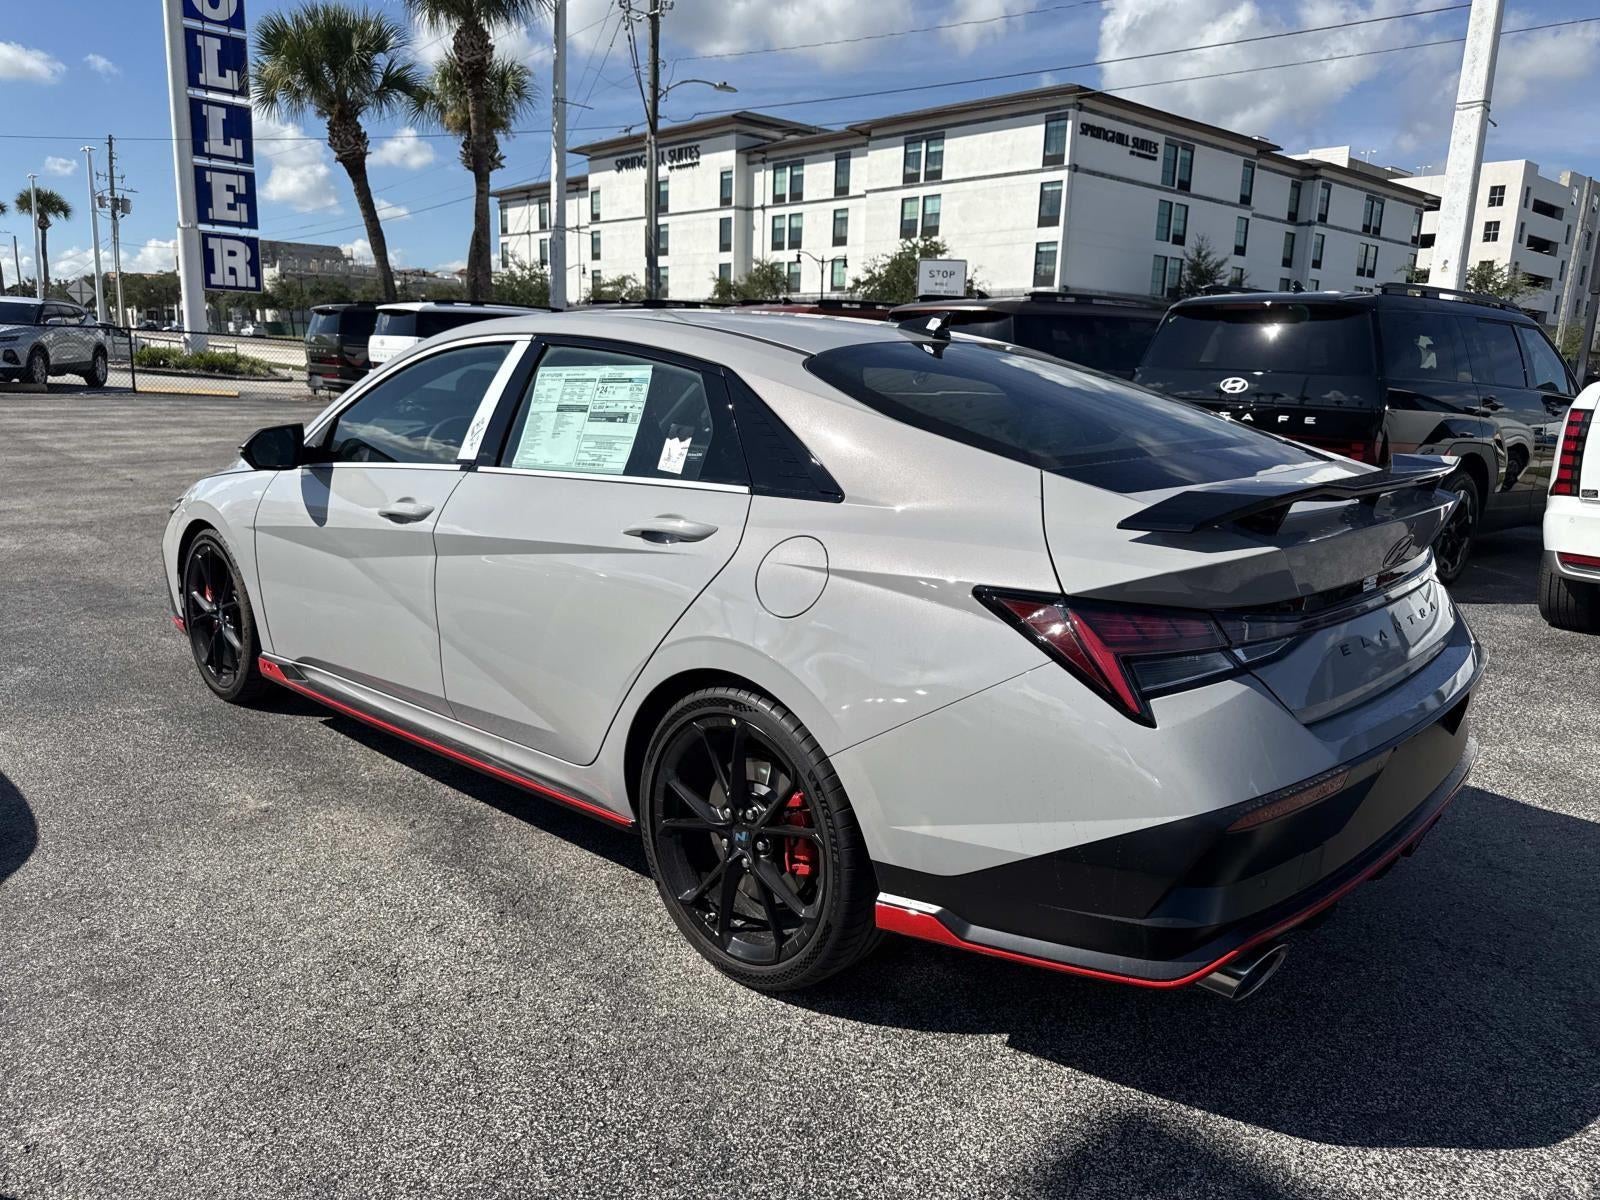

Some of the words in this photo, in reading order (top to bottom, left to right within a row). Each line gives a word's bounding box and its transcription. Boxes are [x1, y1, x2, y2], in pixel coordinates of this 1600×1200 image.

[1080, 122, 1131, 147] SPRINGHILL
[1131, 136, 1160, 155] SUITES
[615, 150, 667, 174] SPRINGL
[668, 145, 700, 164] SUITES
[928, 270, 956, 279] STOP
[1277, 415, 1316, 425] FE
[1339, 602, 1437, 657] ELANTRA
